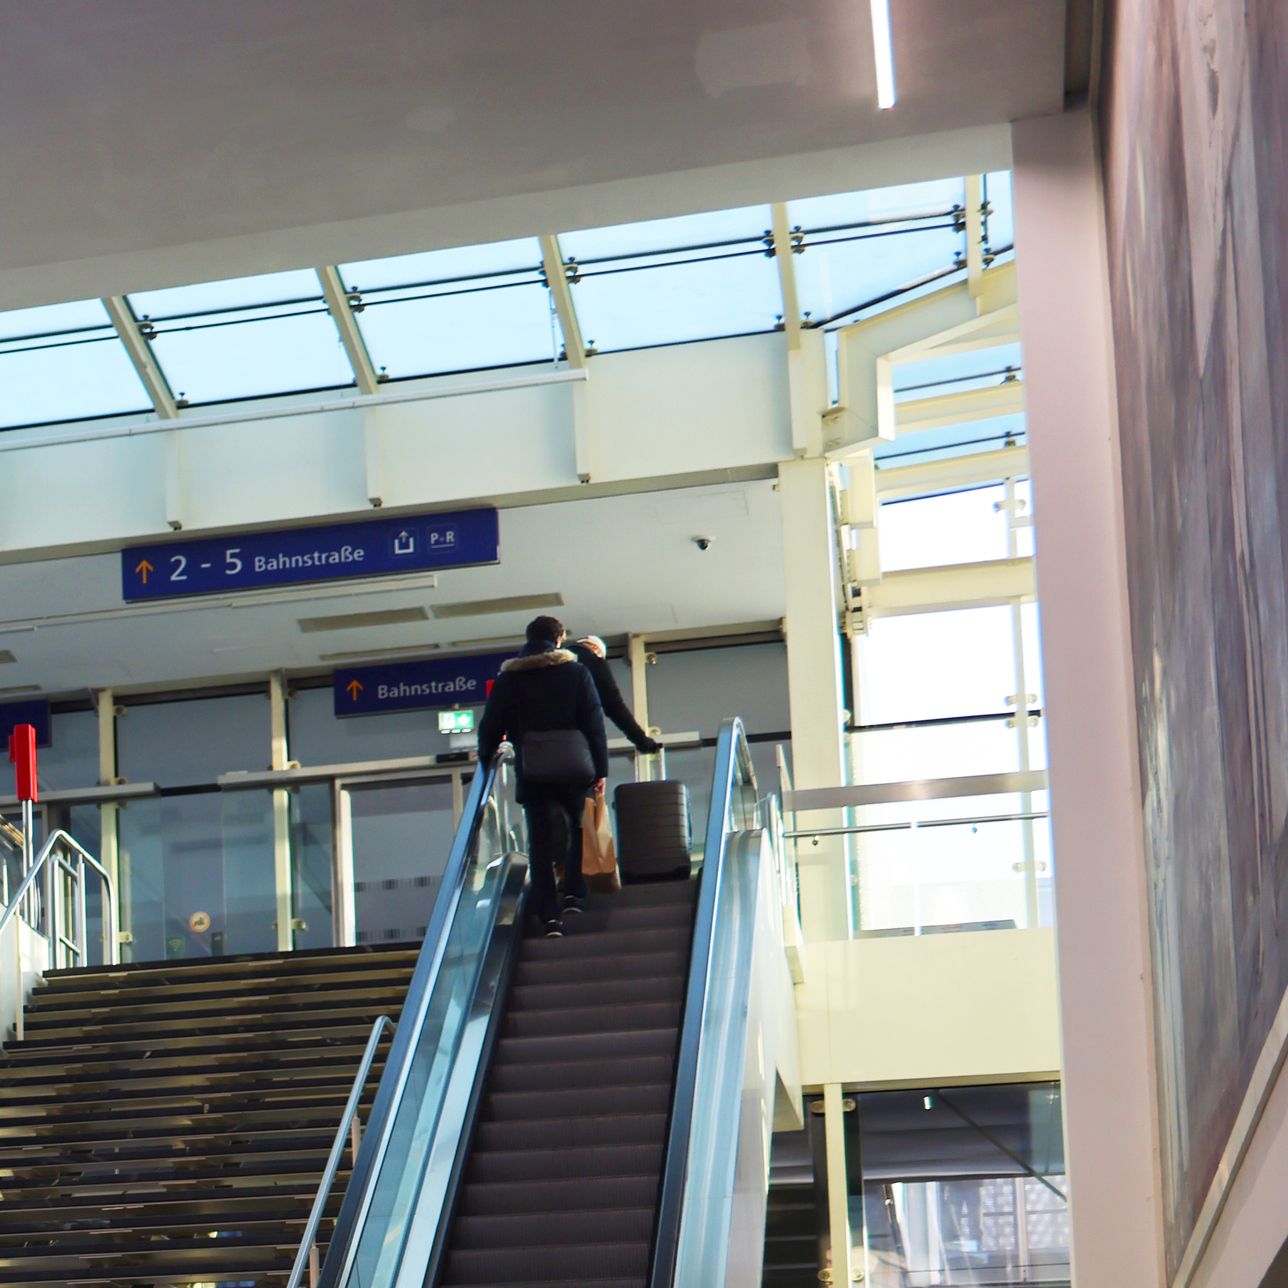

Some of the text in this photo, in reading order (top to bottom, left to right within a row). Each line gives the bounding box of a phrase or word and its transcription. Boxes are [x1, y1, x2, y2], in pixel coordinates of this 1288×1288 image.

[169, 555, 188, 581] 2
[225, 549, 243, 575] 5
[254, 545, 365, 573] Bahnstraße
[377, 676, 477, 700] Bahnstraße
